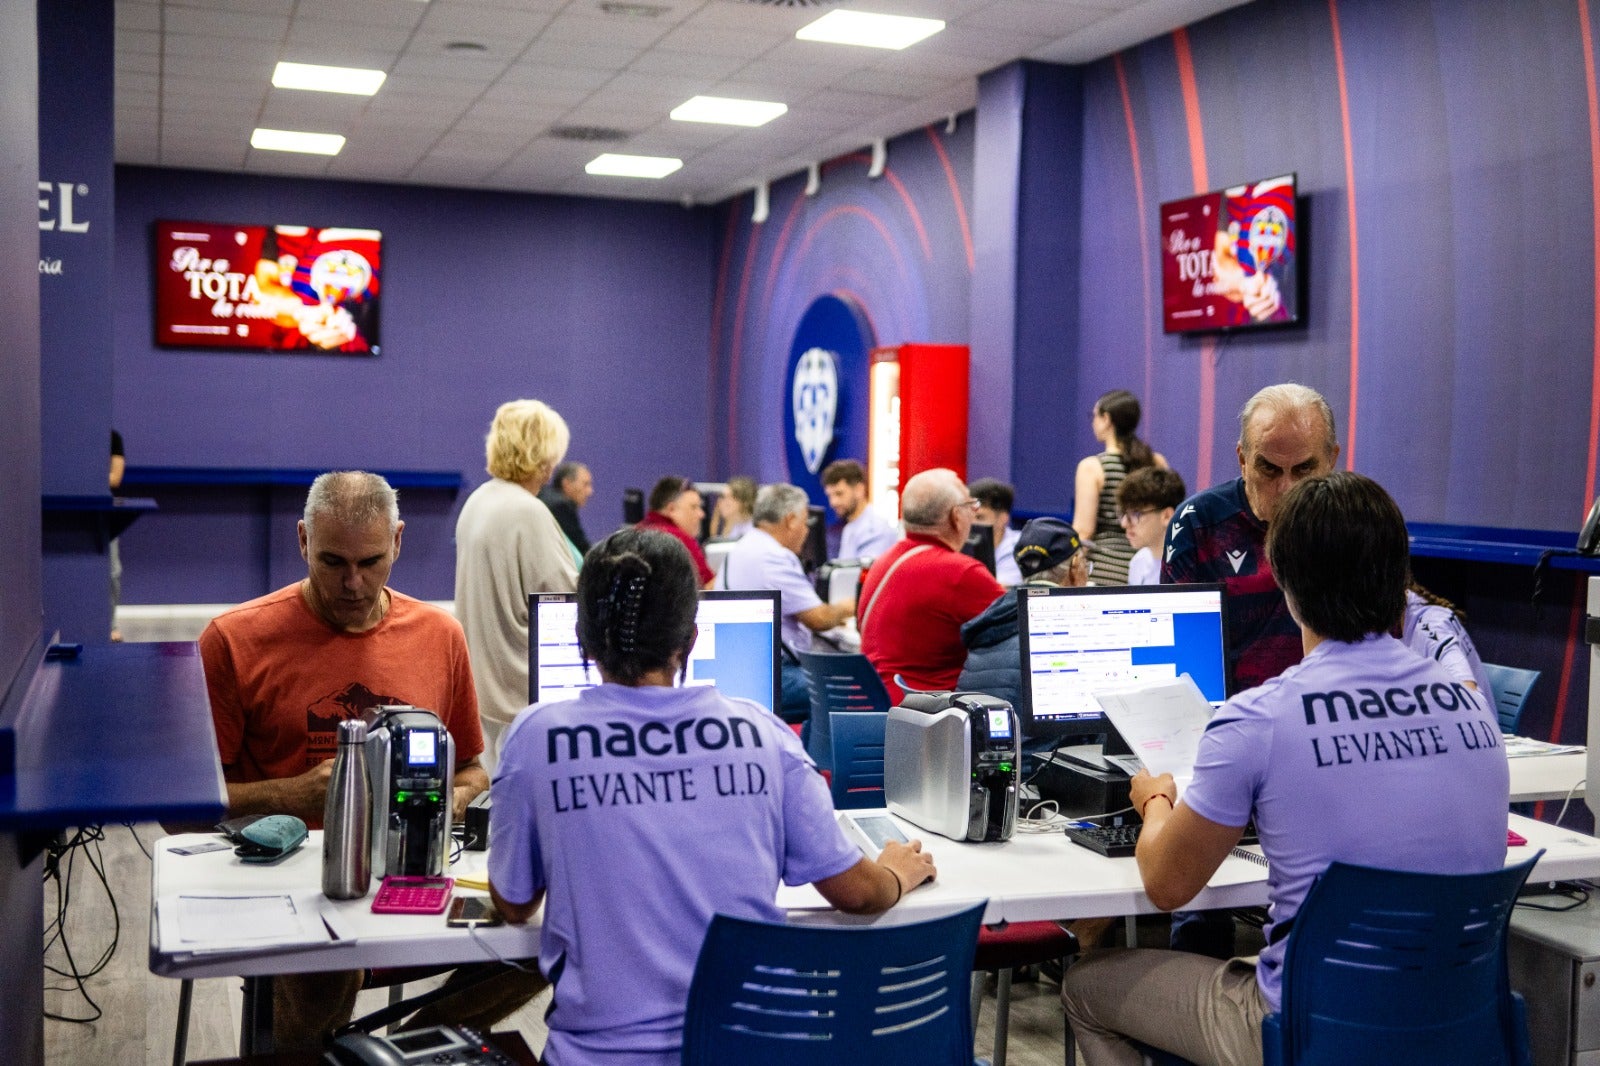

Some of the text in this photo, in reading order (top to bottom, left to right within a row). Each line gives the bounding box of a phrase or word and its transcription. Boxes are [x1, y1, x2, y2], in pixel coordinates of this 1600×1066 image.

[1301, 682, 1481, 725] macron
[547, 717, 762, 764] macron
[1311, 726, 1448, 767] LEVANTE
[552, 762, 768, 813] LEVANTE U.D.
